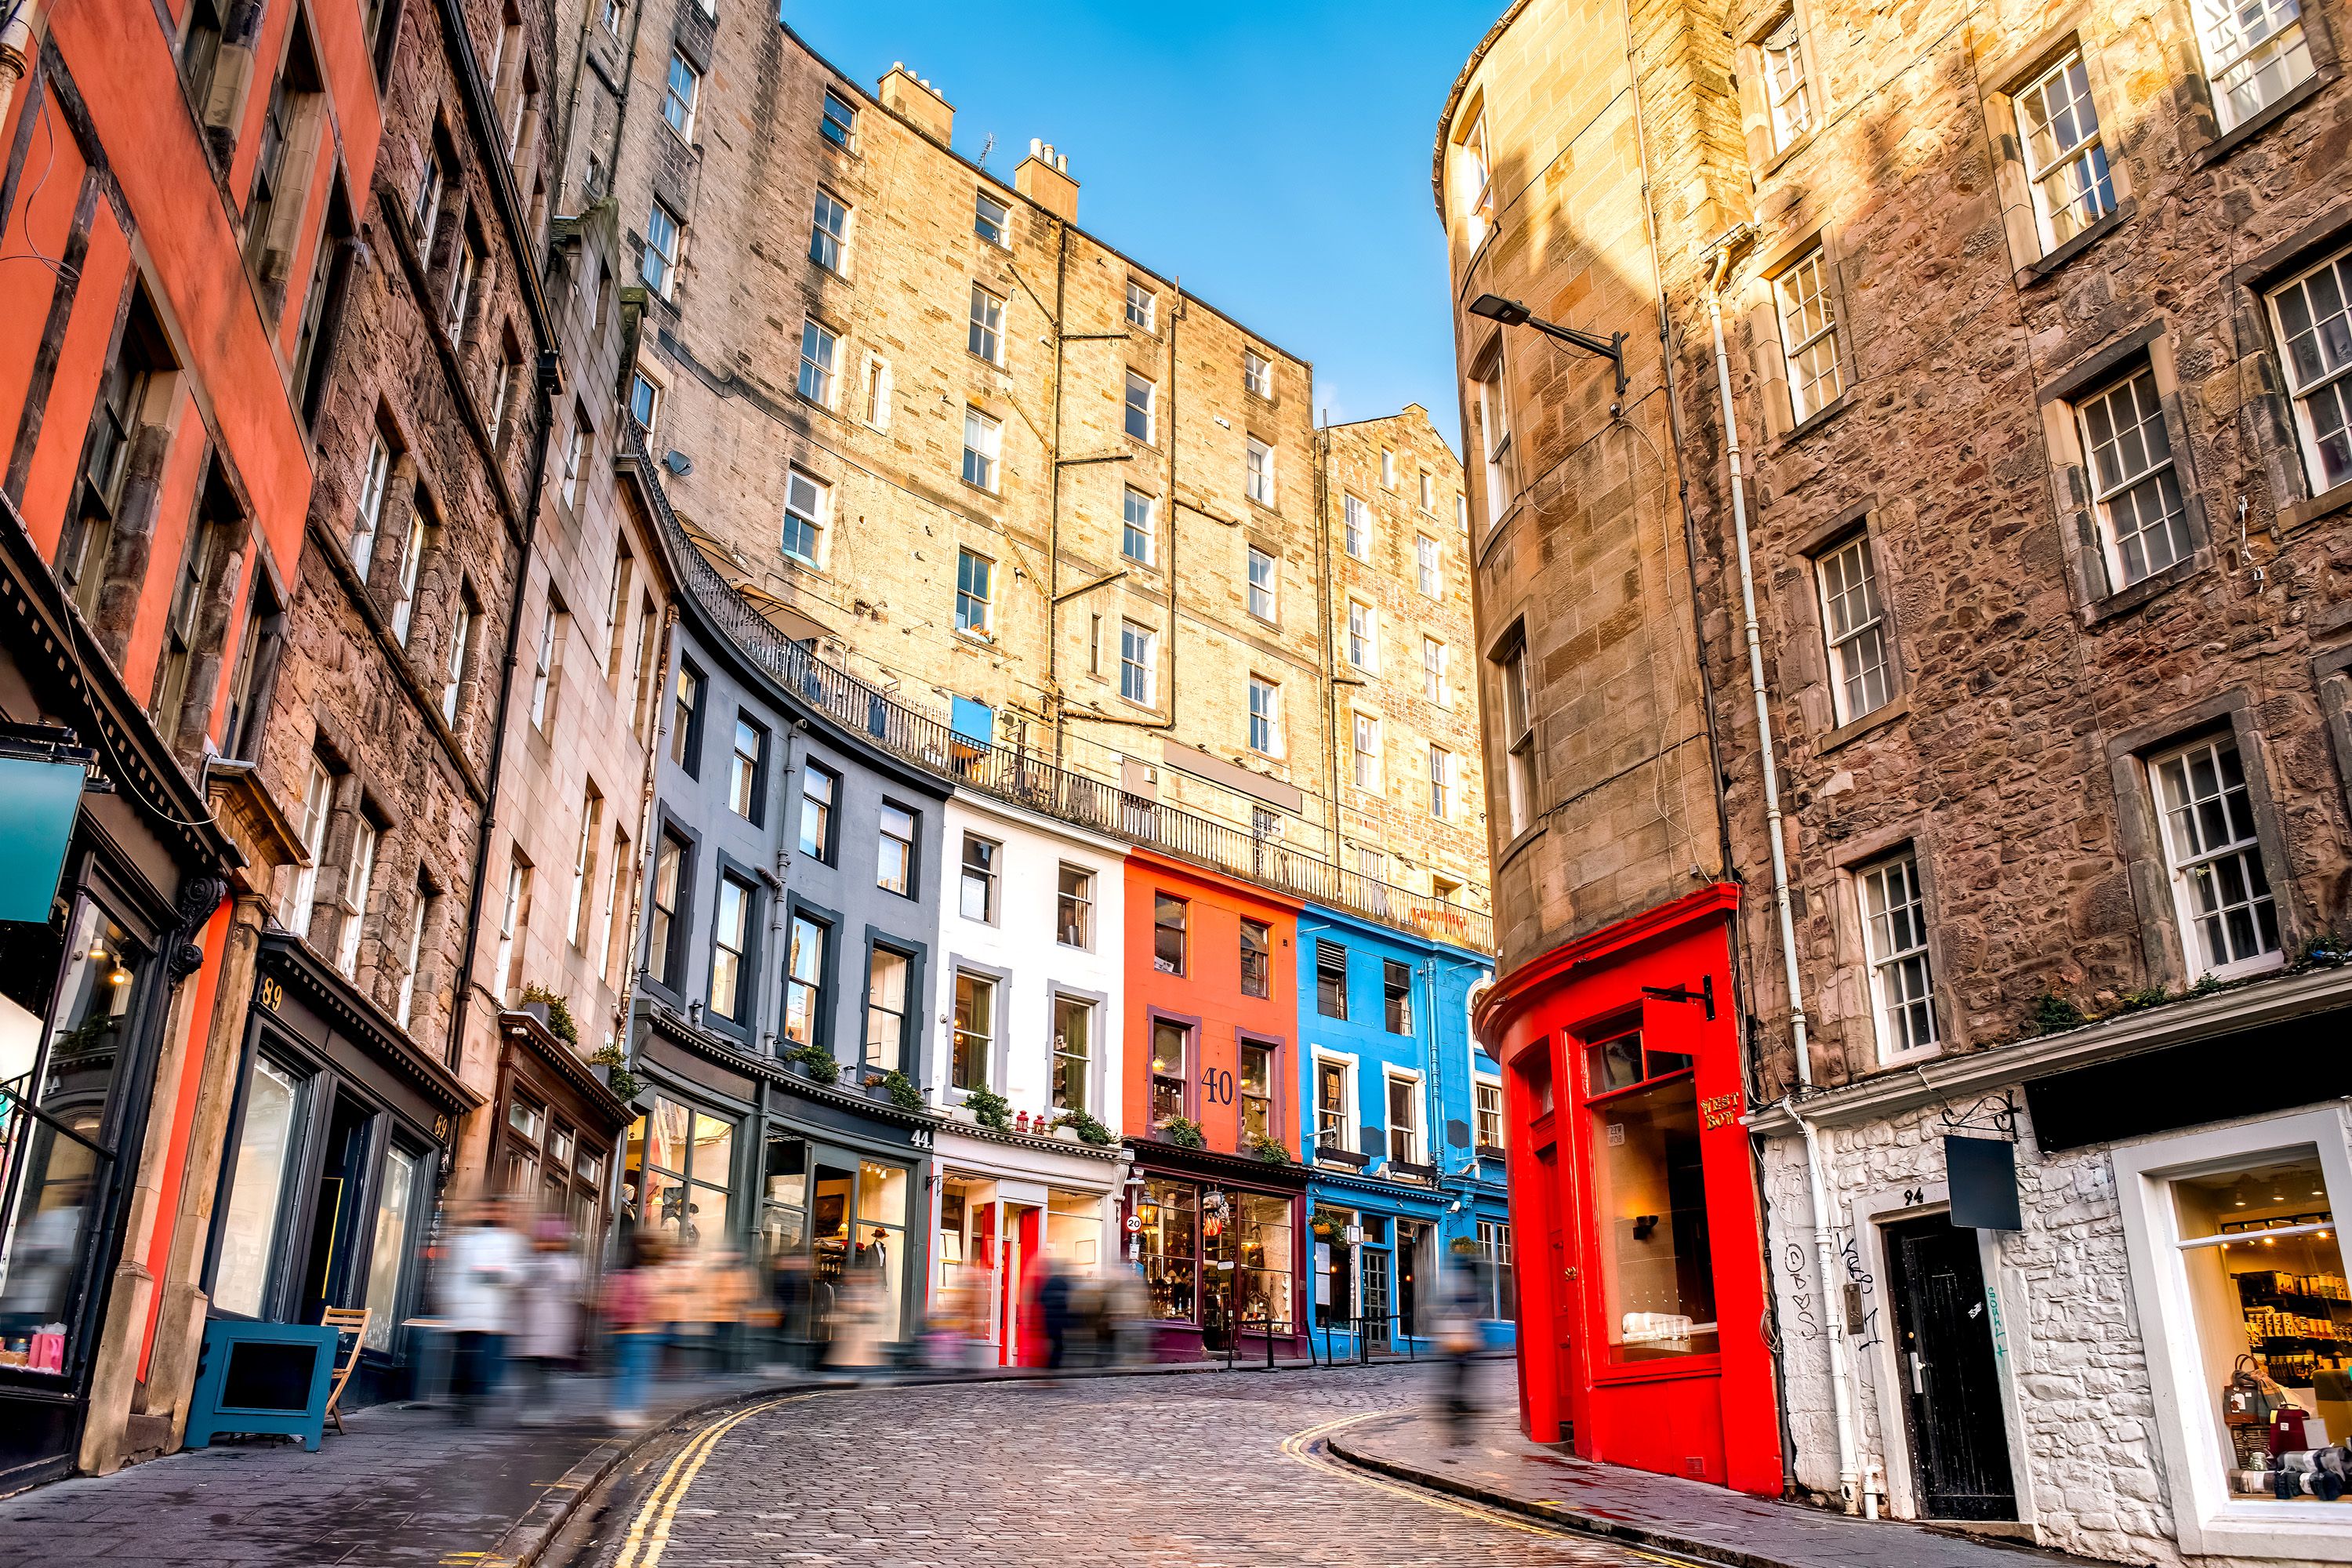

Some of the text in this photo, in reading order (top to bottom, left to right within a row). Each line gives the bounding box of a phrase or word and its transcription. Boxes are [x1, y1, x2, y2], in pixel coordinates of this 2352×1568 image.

[263, 977, 282, 1011] 89
[1201, 1067, 1233, 1105] 40
[1700, 1092, 1739, 1116] WEST
[434, 1115, 447, 1138] 89
[1706, 1109, 1736, 1129] BOW
[1904, 1186, 1924, 1206] 94
[1128, 1219, 1140, 1228] 20
